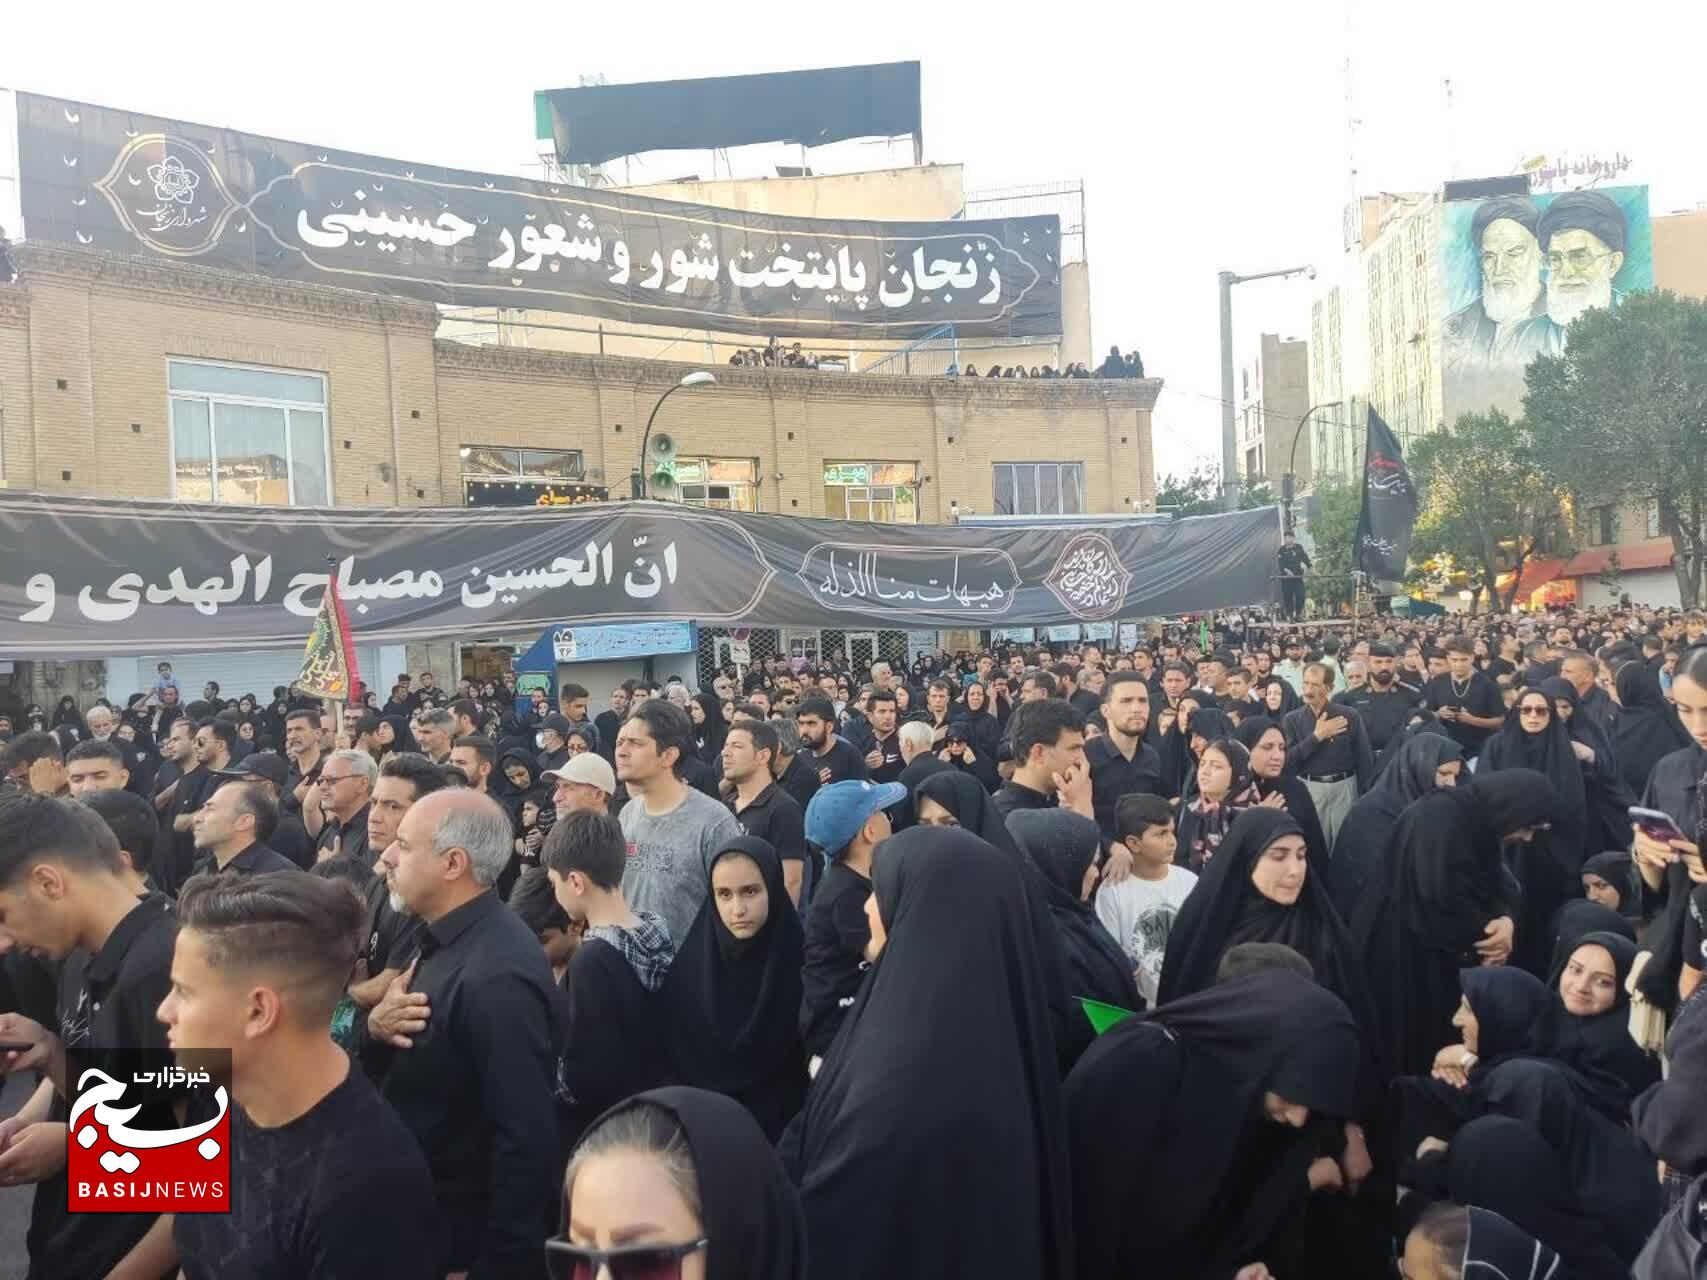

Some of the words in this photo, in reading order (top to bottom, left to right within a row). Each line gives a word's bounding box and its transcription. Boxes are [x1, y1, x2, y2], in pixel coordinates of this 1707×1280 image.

[297, 189, 477, 253] حسینی
[487, 213, 602, 272] شعور
[608, 240, 631, 285] و
[638, 232, 720, 294] شور
[728, 242, 867, 310] پایتخت
[878, 244, 1001, 308] زنجان
[18, 572, 56, 622] و
[283, 554, 444, 617] مصباح
[461, 540, 613, 608] الحسین
[917, 554, 1005, 608] هیهات
